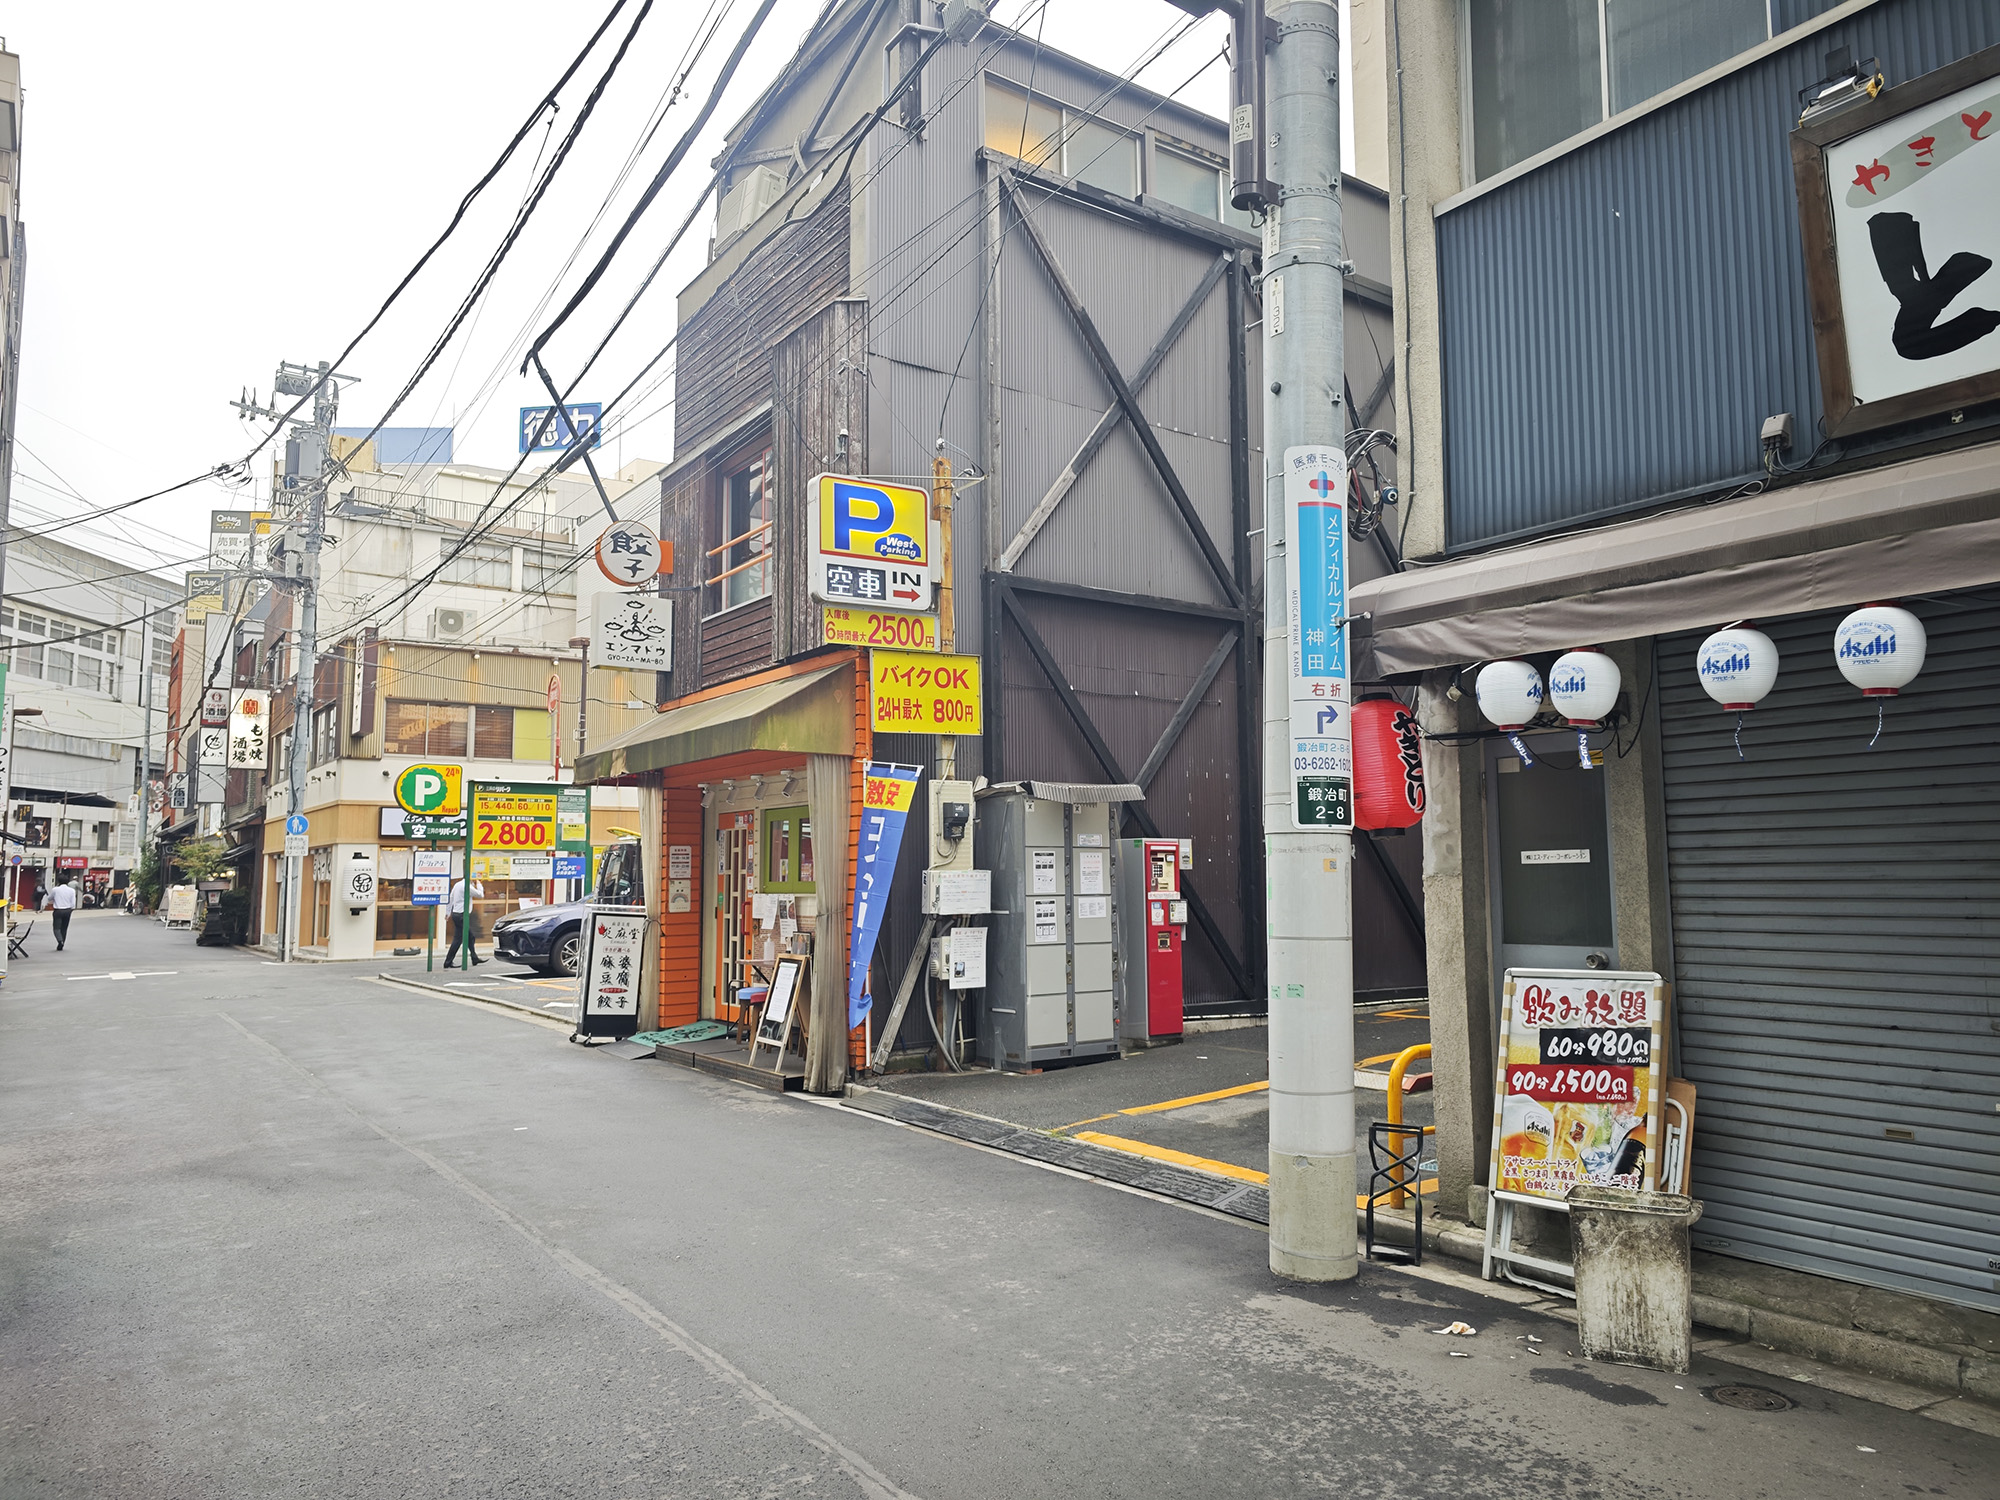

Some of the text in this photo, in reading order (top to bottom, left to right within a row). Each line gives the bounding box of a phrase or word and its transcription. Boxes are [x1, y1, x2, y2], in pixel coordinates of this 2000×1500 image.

[1293, 453, 1343, 470] 医療モール
[886, 535, 914, 550] West
[610, 530, 652, 578] 餃子
[880, 543, 917, 559] Parking
[827, 566, 882, 599] 空車
[892, 571, 920, 587] IN
[1327, 514, 1343, 671] メディカルプライム
[825, 608, 850, 621] 入庫後
[605, 641, 666, 657] エンマドウ
[1306, 628, 1324, 671] 神田
[1840, 634, 1896, 658] Asahi
[1701, 653, 1750, 675] Asahi
[880, 665, 970, 690] バイクOK
[1312, 682, 1341, 697] 右折
[878, 696, 974, 723] 24H最大 800円
[445, 767, 460, 778] 24h
[414, 774, 441, 806] P
[1308, 787, 1348, 802] 鍛冶町
[441, 805, 459, 814] Repark
[1315, 805, 1344, 820] 2-8
[411, 824, 427, 838] 空
[478, 822, 553, 847] 2,800円
[597, 994, 629, 1009] 餃子
[1523, 984, 1647, 1026] 飲み放題
[1526, 1119, 1551, 1138] Asahi
[1504, 1156, 1578, 1170] アサヒスーパードライ
